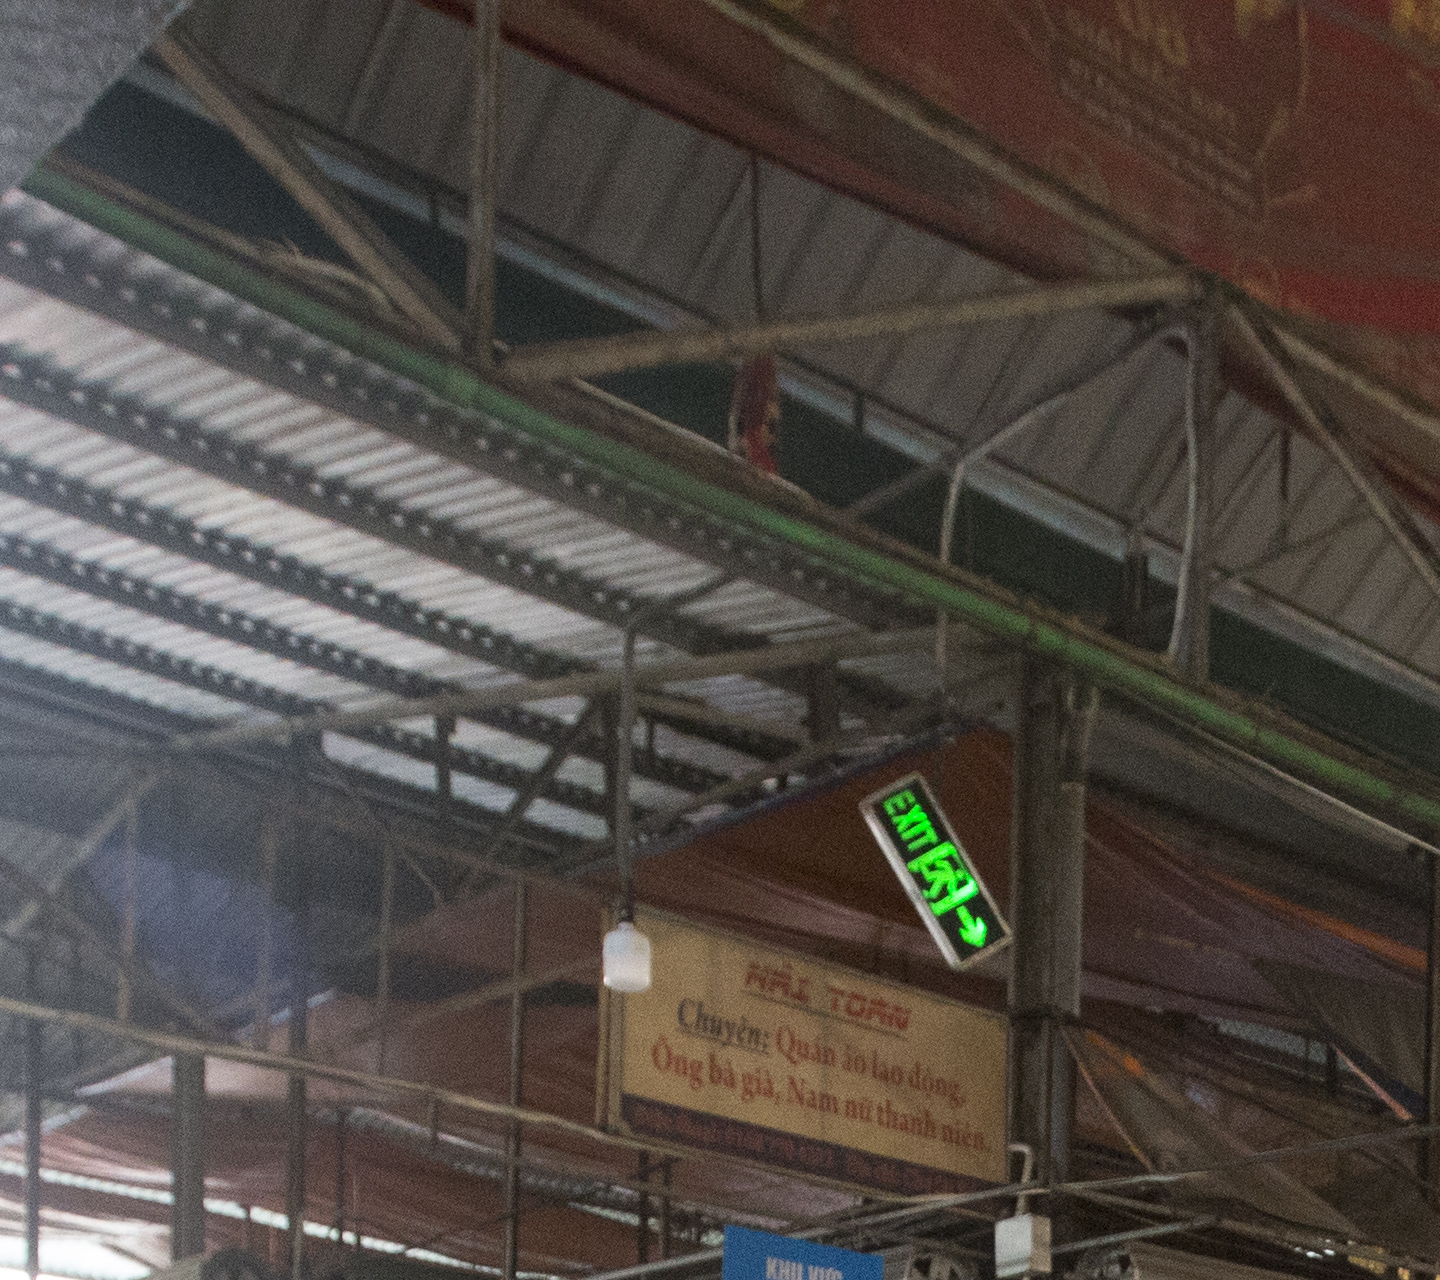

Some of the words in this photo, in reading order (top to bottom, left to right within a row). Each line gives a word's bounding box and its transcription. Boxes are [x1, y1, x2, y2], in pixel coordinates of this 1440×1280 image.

[883, 788, 938, 852] EXIT
[651, 1035, 703, 1091] Ông
[788, 1075, 840, 1118] Nam
[877, 1096, 938, 1141] thanh
[872, 1050, 904, 1087] lao
